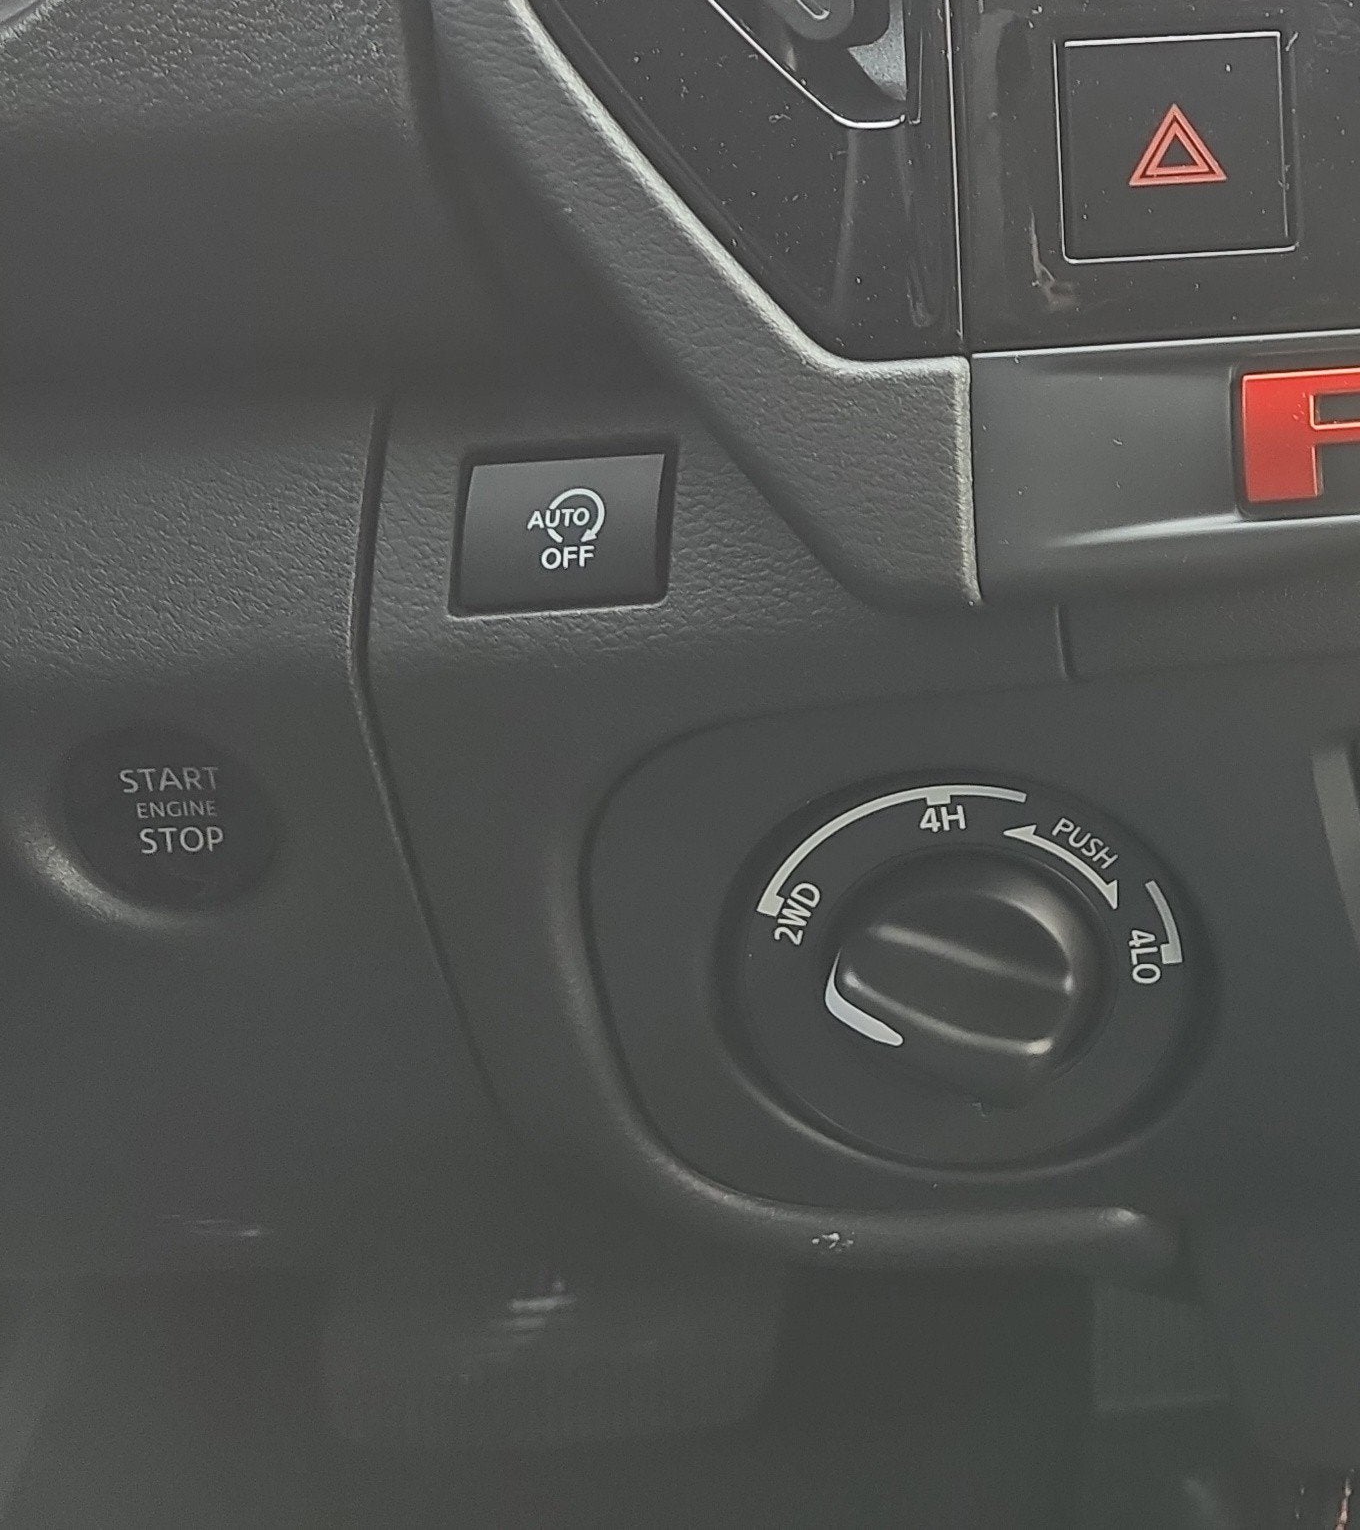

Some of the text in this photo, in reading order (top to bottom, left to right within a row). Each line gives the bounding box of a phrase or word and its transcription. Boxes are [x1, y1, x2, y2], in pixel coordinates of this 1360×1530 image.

[527, 507, 590, 530] AUTO
[541, 545, 595, 570] OFF
[120, 766, 218, 793] START
[137, 800, 218, 819] ENGINE
[919, 805, 967, 833] 4H
[140, 826, 224, 854] STOP
[1051, 817, 1118, 870] PUSH
[774, 881, 822, 946] 2WD
[1129, 927, 1162, 985] 4LO
